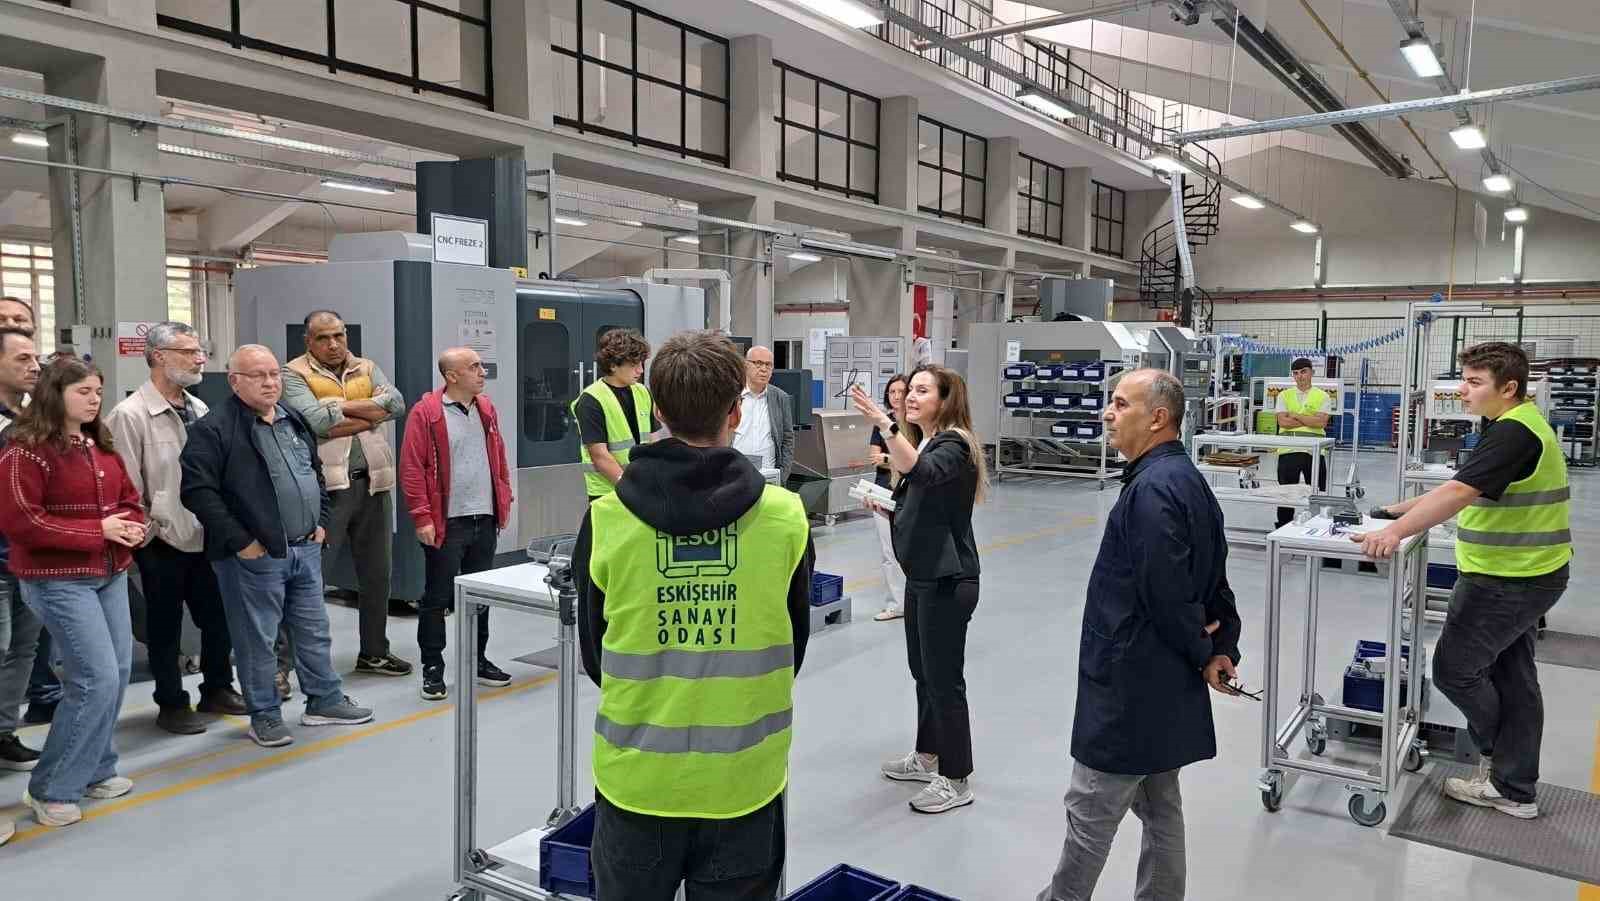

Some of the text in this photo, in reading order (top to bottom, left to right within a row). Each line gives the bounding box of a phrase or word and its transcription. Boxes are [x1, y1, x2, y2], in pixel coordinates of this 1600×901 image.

[437, 235, 484, 249] CNC FREZE 2
[657, 580, 737, 605] ESKİŞEHİR
[658, 604, 736, 627] SANAYİ
[658, 627, 736, 645] ODASI
